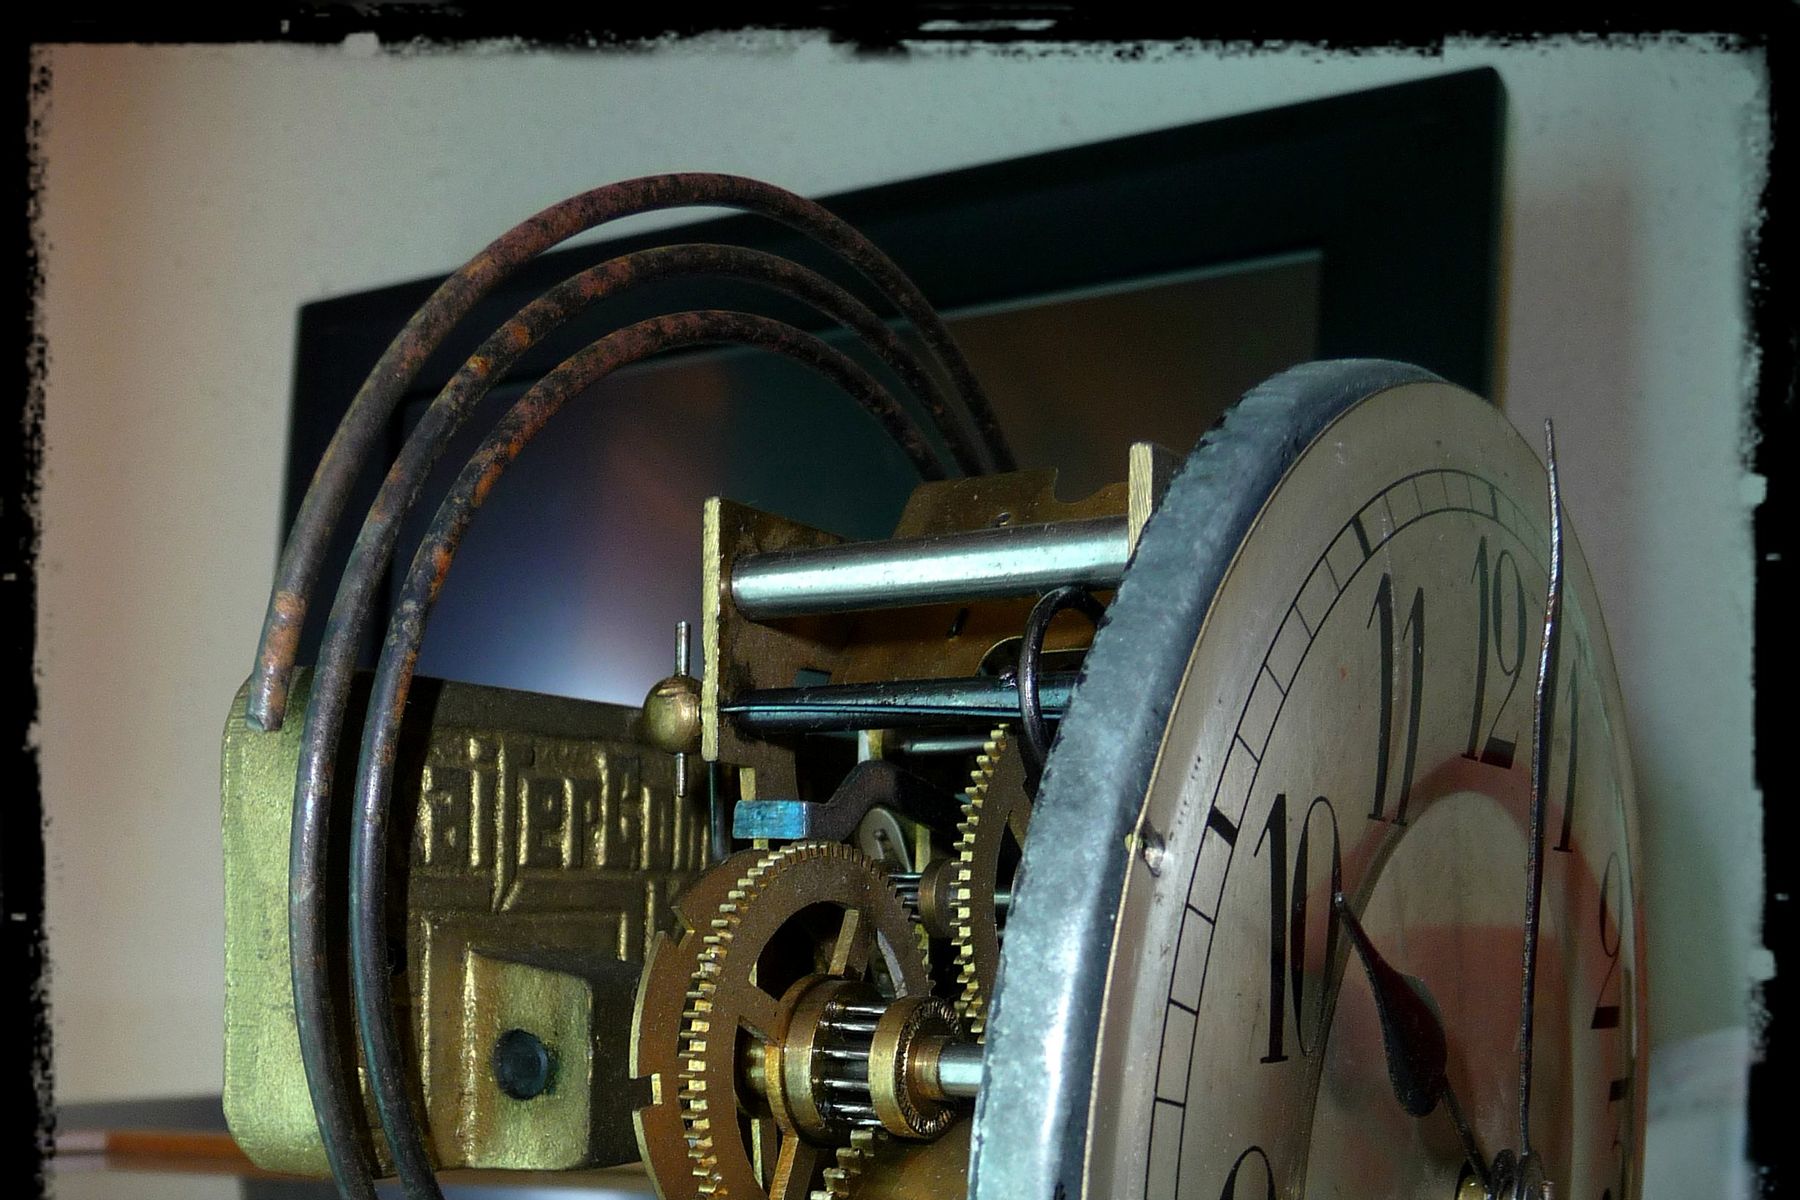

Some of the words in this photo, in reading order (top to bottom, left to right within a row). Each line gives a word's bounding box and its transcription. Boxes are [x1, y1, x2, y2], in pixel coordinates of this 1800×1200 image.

[1367, 573, 1425, 826] 11
[1461, 535, 1527, 769] 12
[1554, 660, 1578, 853] 1
[1254, 794, 1342, 1064] 10
[1590, 852, 1623, 1029] 2
